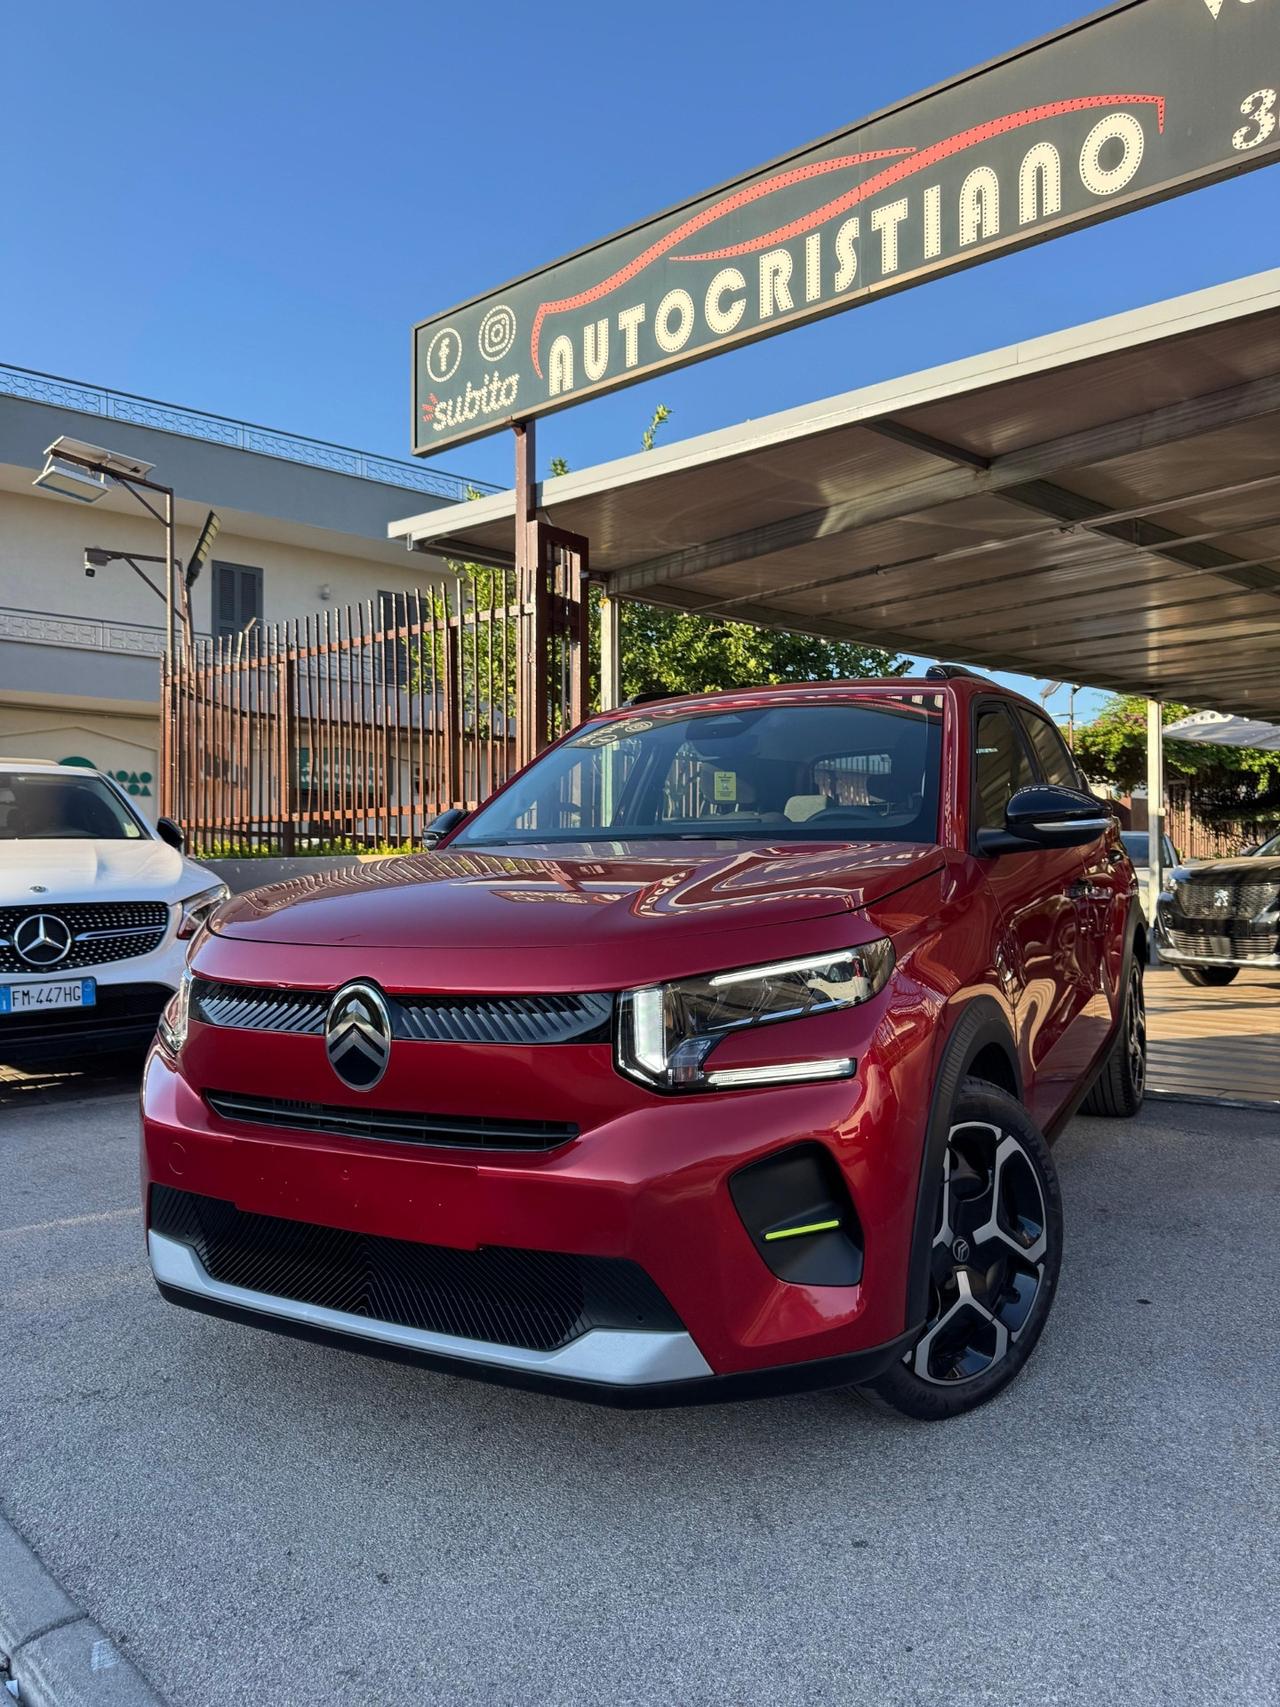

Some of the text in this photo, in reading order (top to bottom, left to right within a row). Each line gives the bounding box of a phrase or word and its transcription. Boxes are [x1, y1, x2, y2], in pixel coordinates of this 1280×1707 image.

[1232, 88, 1280, 150] 3
[548, 112, 1144, 397] AUTOCRISTIANO
[432, 371, 520, 431] subito
